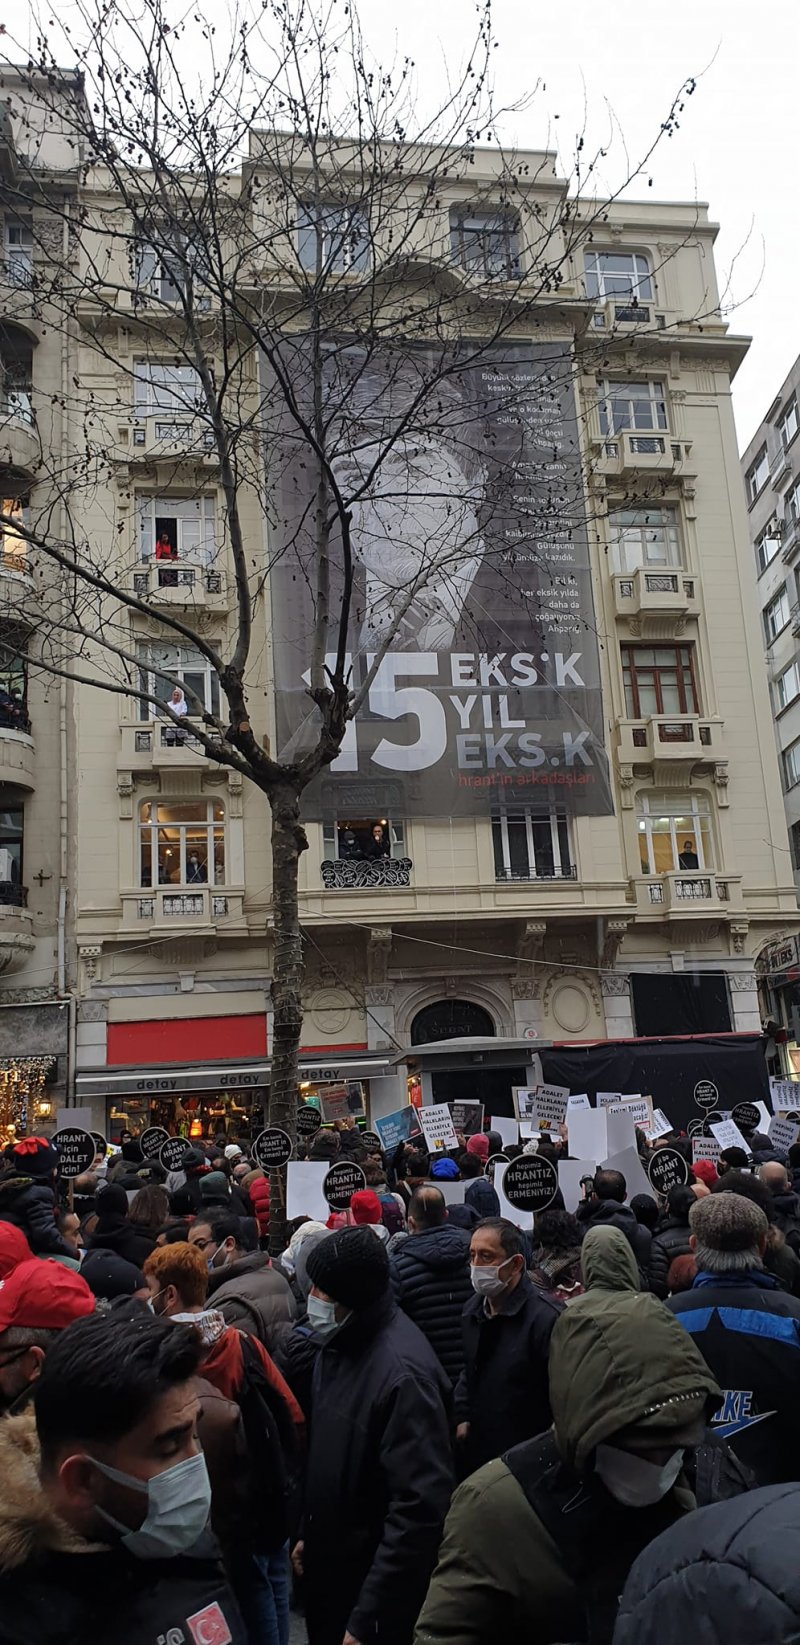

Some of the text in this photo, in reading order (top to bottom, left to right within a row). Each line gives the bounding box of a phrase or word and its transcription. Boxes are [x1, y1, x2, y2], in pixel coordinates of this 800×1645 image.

[513, 495, 536, 504] Senin
[537, 542, 575, 551] Gülüşünü
[545, 552, 576, 562] kazıdık.
[536, 588, 558, 597] eksik
[560, 588, 579, 598] yılda
[548, 600, 580, 609] daha da
[535, 612, 580, 622] çoğalıyoruz
[300, 652, 447, 772] 15
[449, 694, 527, 729] YIL
[301, 1068, 340, 1081] detay
[137, 1079, 177, 1091] detay
[220, 1073, 260, 1087] detay
[541, 1089, 564, 1098] ADALET
[535, 1096, 568, 1107] HALKLARIN
[424, 1109, 444, 1117] ADALET
[536, 1103, 564, 1114] ELLERİYLE
[422, 1116, 451, 1125] HALKLARIN
[536, 1111, 562, 1120] GELECEK!
[57, 1134, 87, 1143] HRANT
[260, 1139, 280, 1148] HRANT
[63, 1144, 79, 1154] için
[162, 1143, 186, 1158] HRANT
[60, 1154, 88, 1163] DALET
[61, 1165, 80, 1174] için!
[516, 1161, 542, 1170] hepimiz
[652, 1157, 679, 1177] HRANT
[326, 1172, 362, 1187] HRANTIZ
[507, 1168, 553, 1182] HRANTIZ
[518, 1181, 543, 1190] hepimiz
[508, 1187, 554, 1199] ERMENİYİZ!
